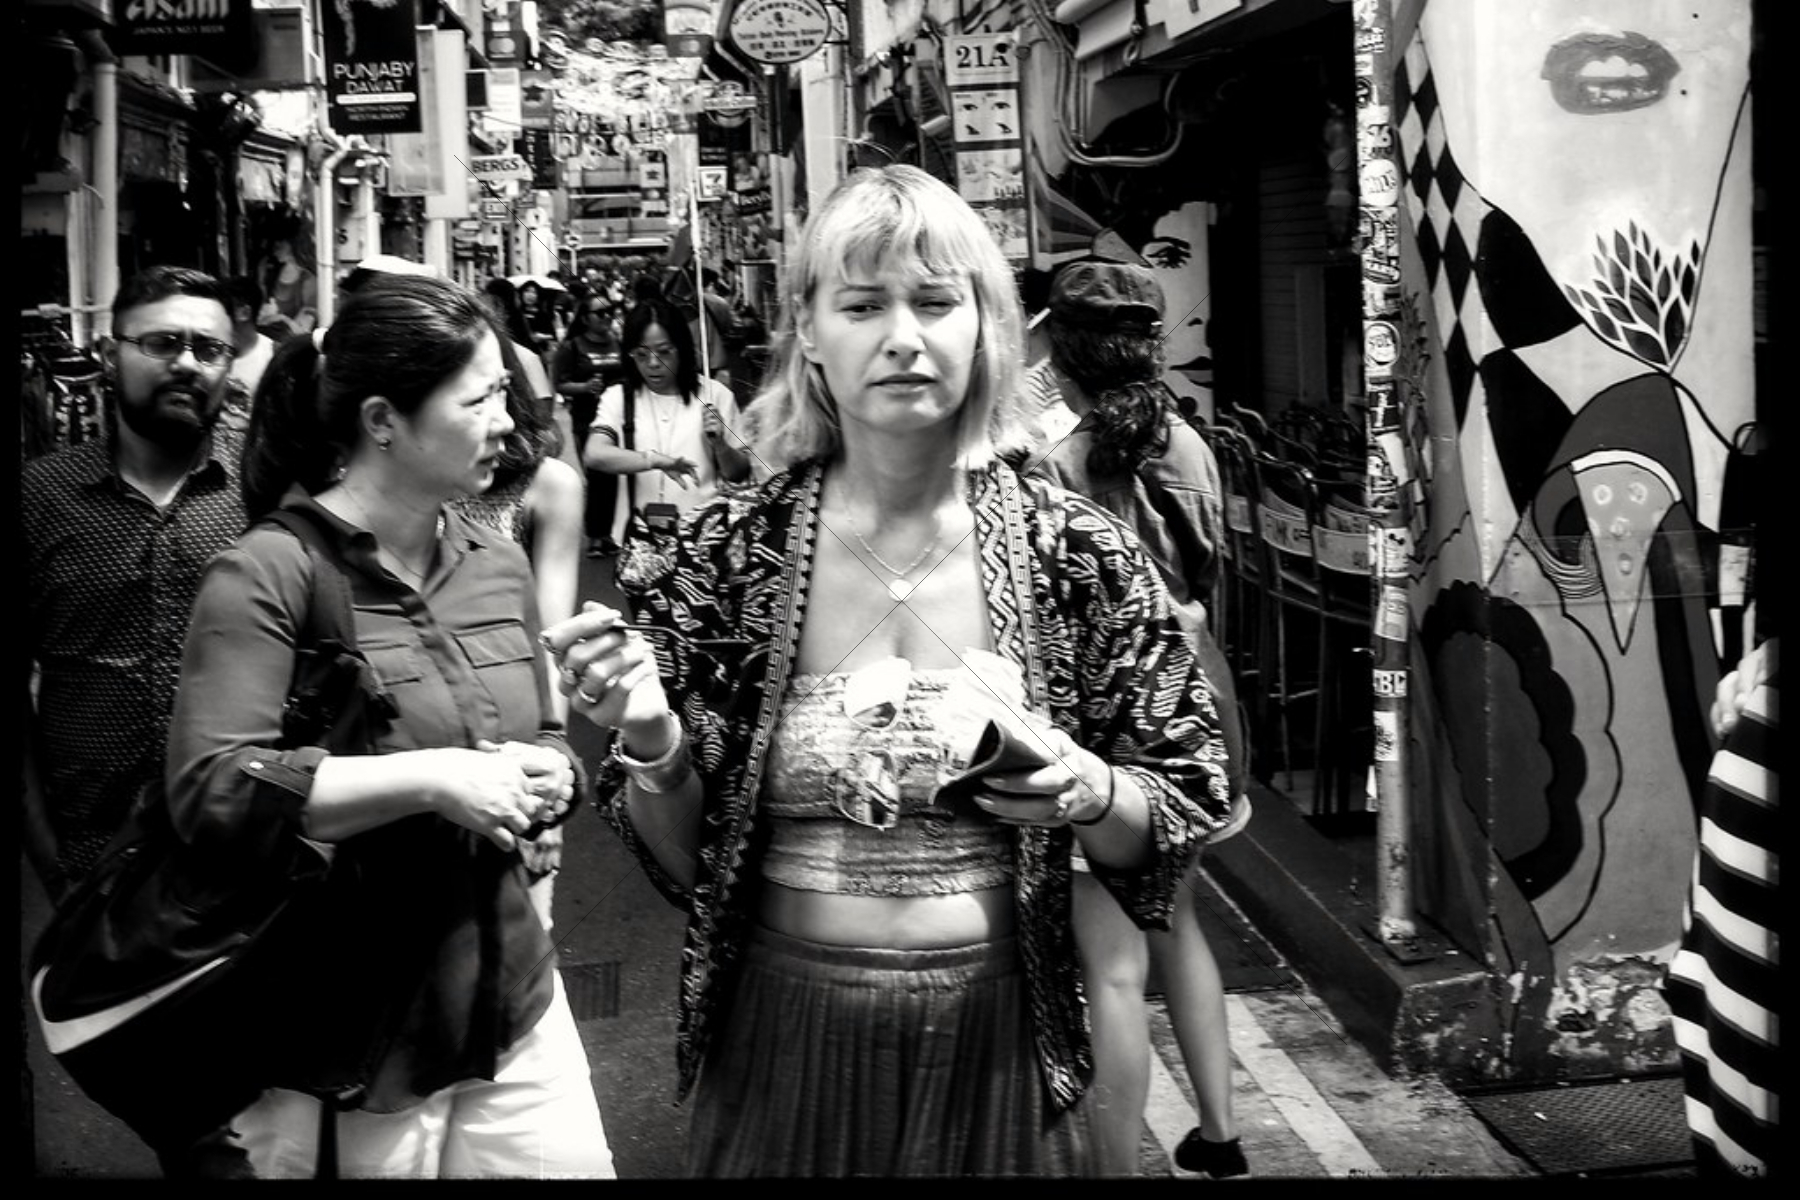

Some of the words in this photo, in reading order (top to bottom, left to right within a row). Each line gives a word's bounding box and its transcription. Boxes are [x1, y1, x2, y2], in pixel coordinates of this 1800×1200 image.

[956, 44, 1010, 69] 21A
[333, 60, 415, 80] PUNJABY
[346, 79, 404, 94] DAWAT
